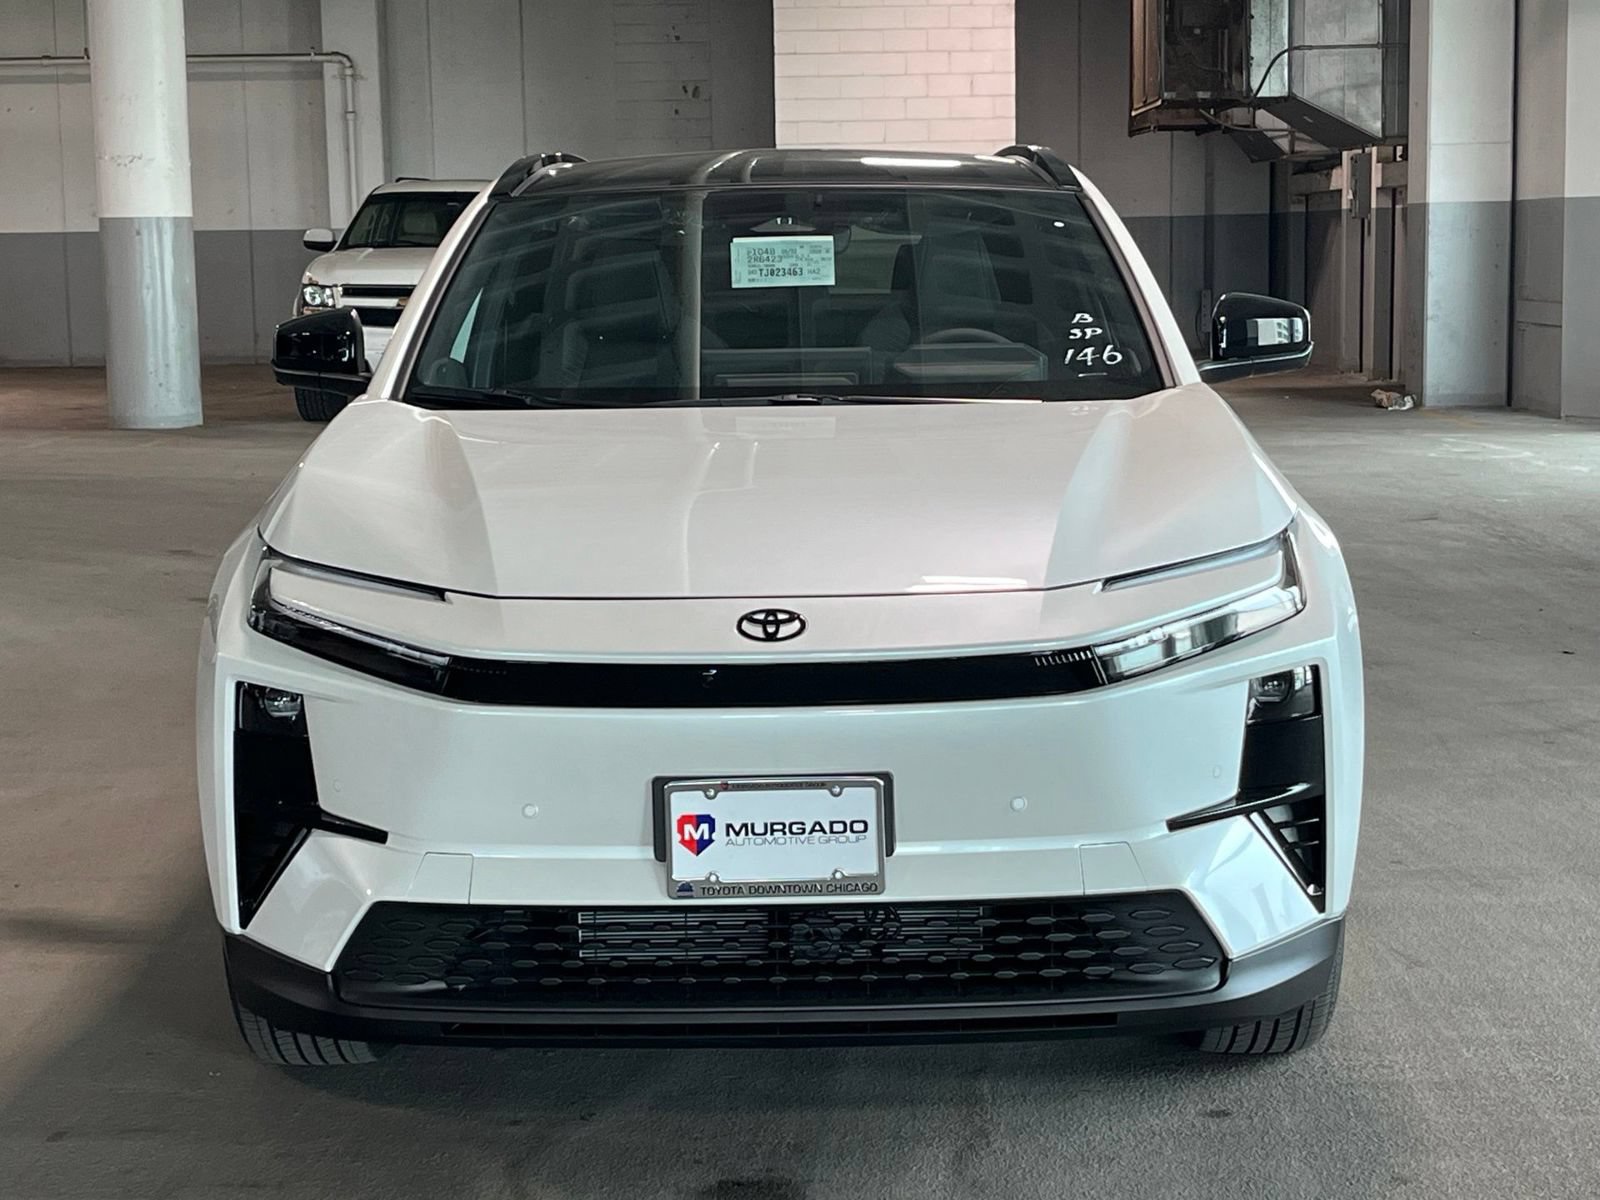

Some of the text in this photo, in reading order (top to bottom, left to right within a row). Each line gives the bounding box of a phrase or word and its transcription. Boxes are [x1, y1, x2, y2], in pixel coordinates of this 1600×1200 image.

[759, 267, 804, 277] TJ023463
[1071, 312, 1094, 324] B
[1064, 344, 1123, 366] 146
[683, 823, 710, 841] M
[725, 820, 869, 837] MURGADO
[725, 835, 867, 847] AUTOMOTIVE GROUP
[701, 882, 878, 897] TOYOTA DOWNTOWN CHICAGO
